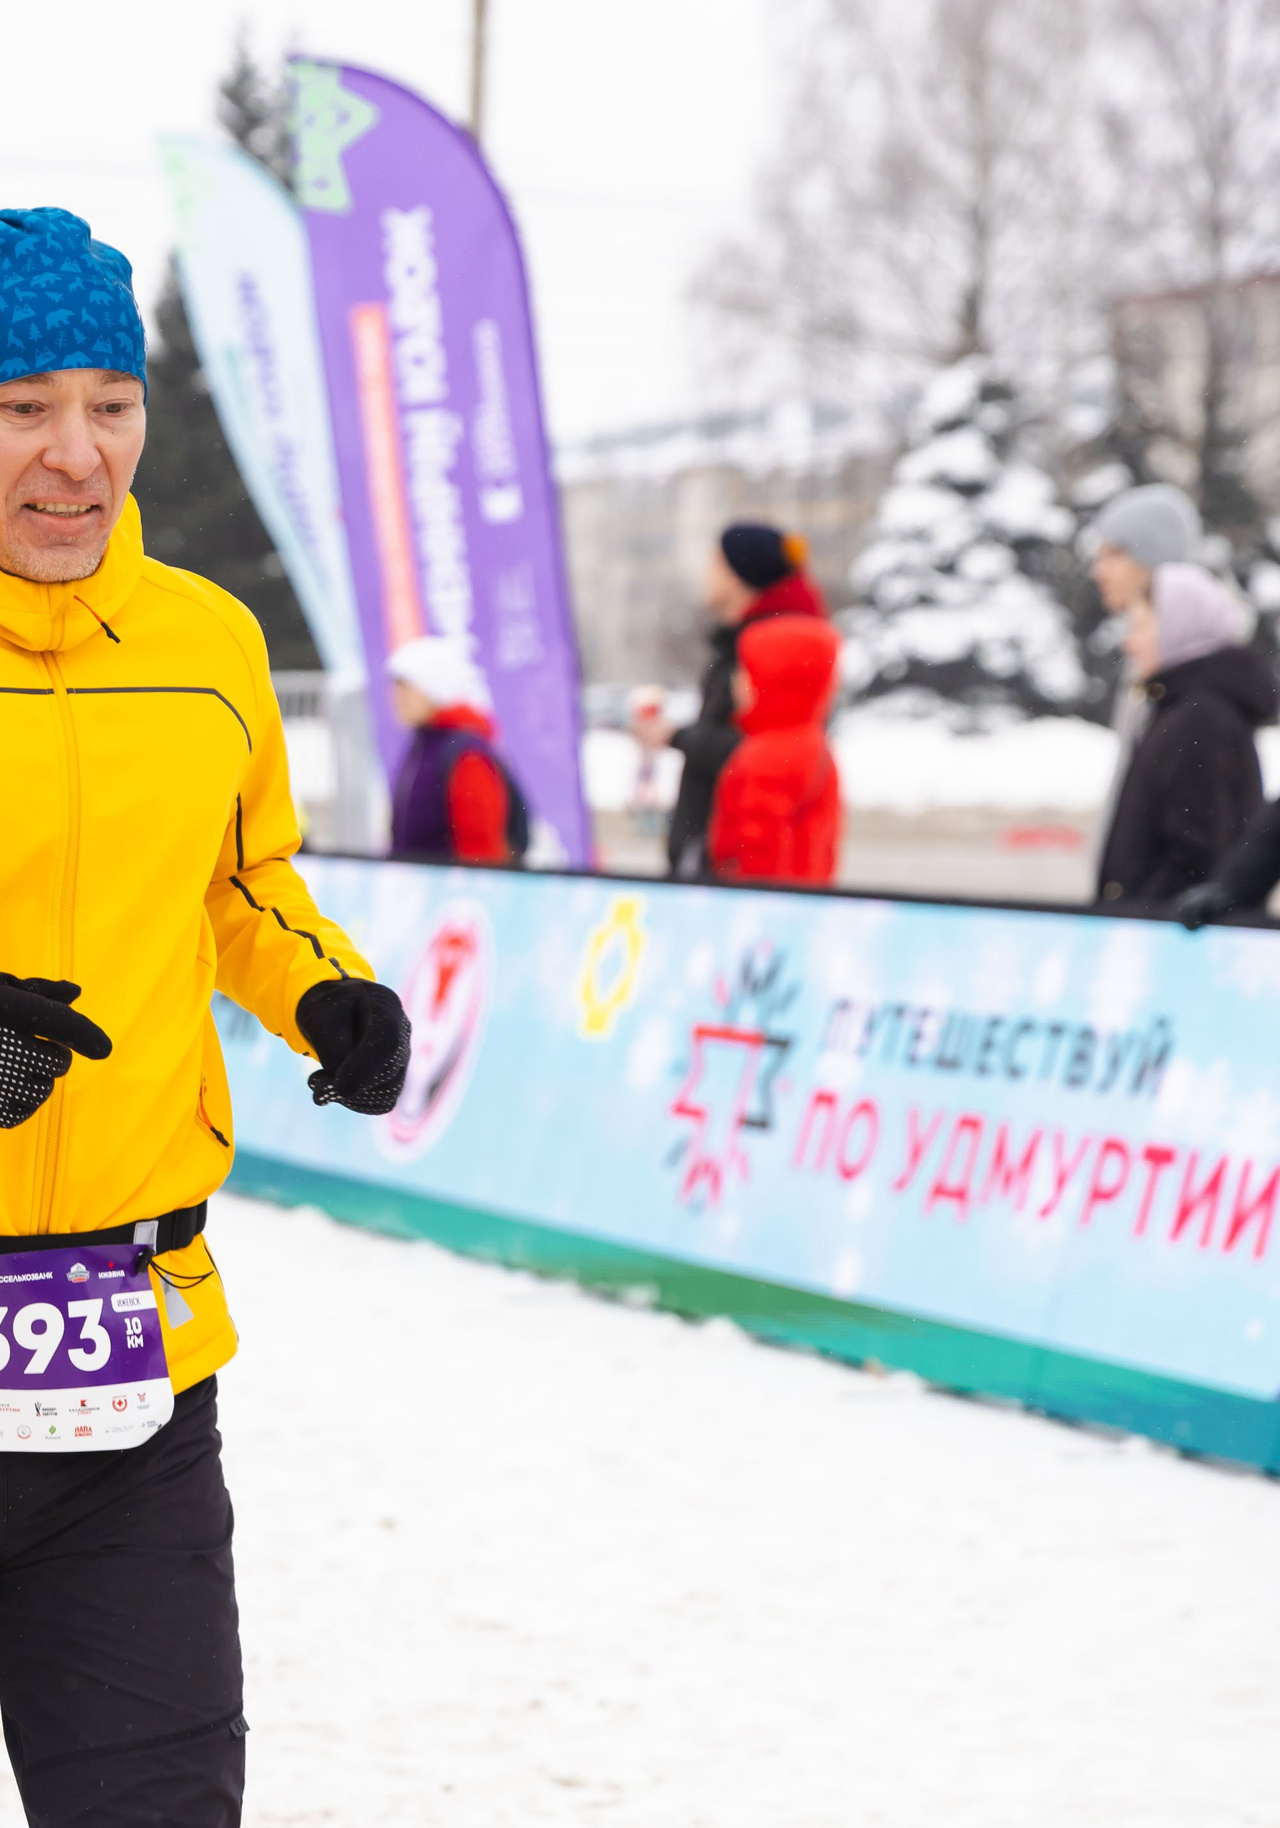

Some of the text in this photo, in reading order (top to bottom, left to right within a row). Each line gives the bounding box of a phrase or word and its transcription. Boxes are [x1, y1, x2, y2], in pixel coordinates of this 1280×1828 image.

[826, 999, 1176, 1096] ПУТЕШЕСТВУЙ
[793, 1090, 1280, 1259] ПО УДМУРТИИ
[98, 1269, 125, 1280] ИЖАВИА
[116, 1297, 141, 1308] ИЖЕВСК
[124, 1317, 143, 1336] 10
[126, 1334, 144, 1349] КМ
